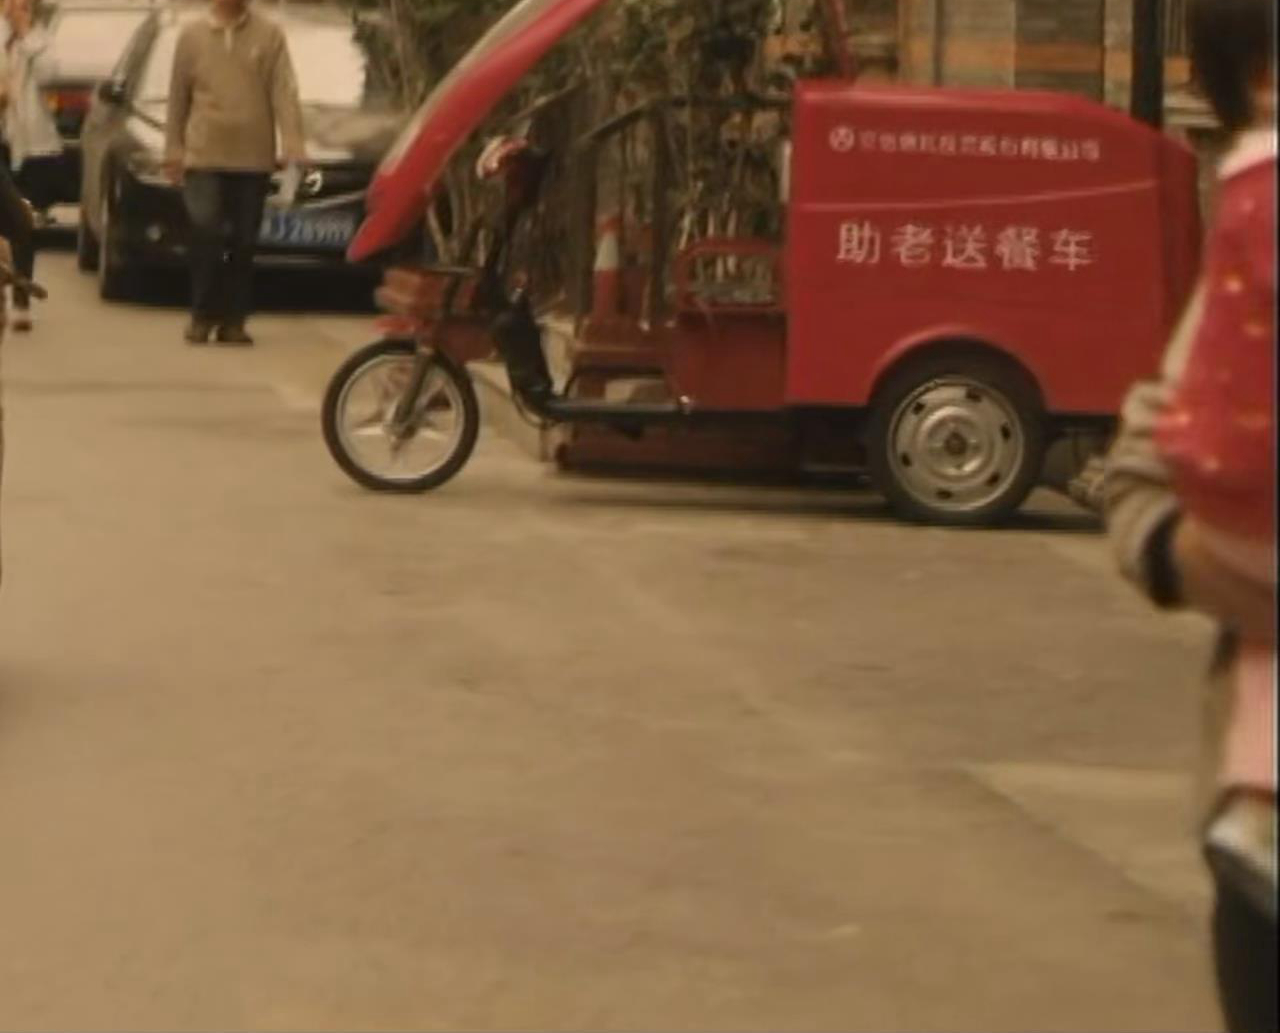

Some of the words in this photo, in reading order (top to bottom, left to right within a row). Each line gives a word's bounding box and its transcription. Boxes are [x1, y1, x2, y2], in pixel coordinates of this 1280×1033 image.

[836, 222, 1094, 271] 助老送餐车
